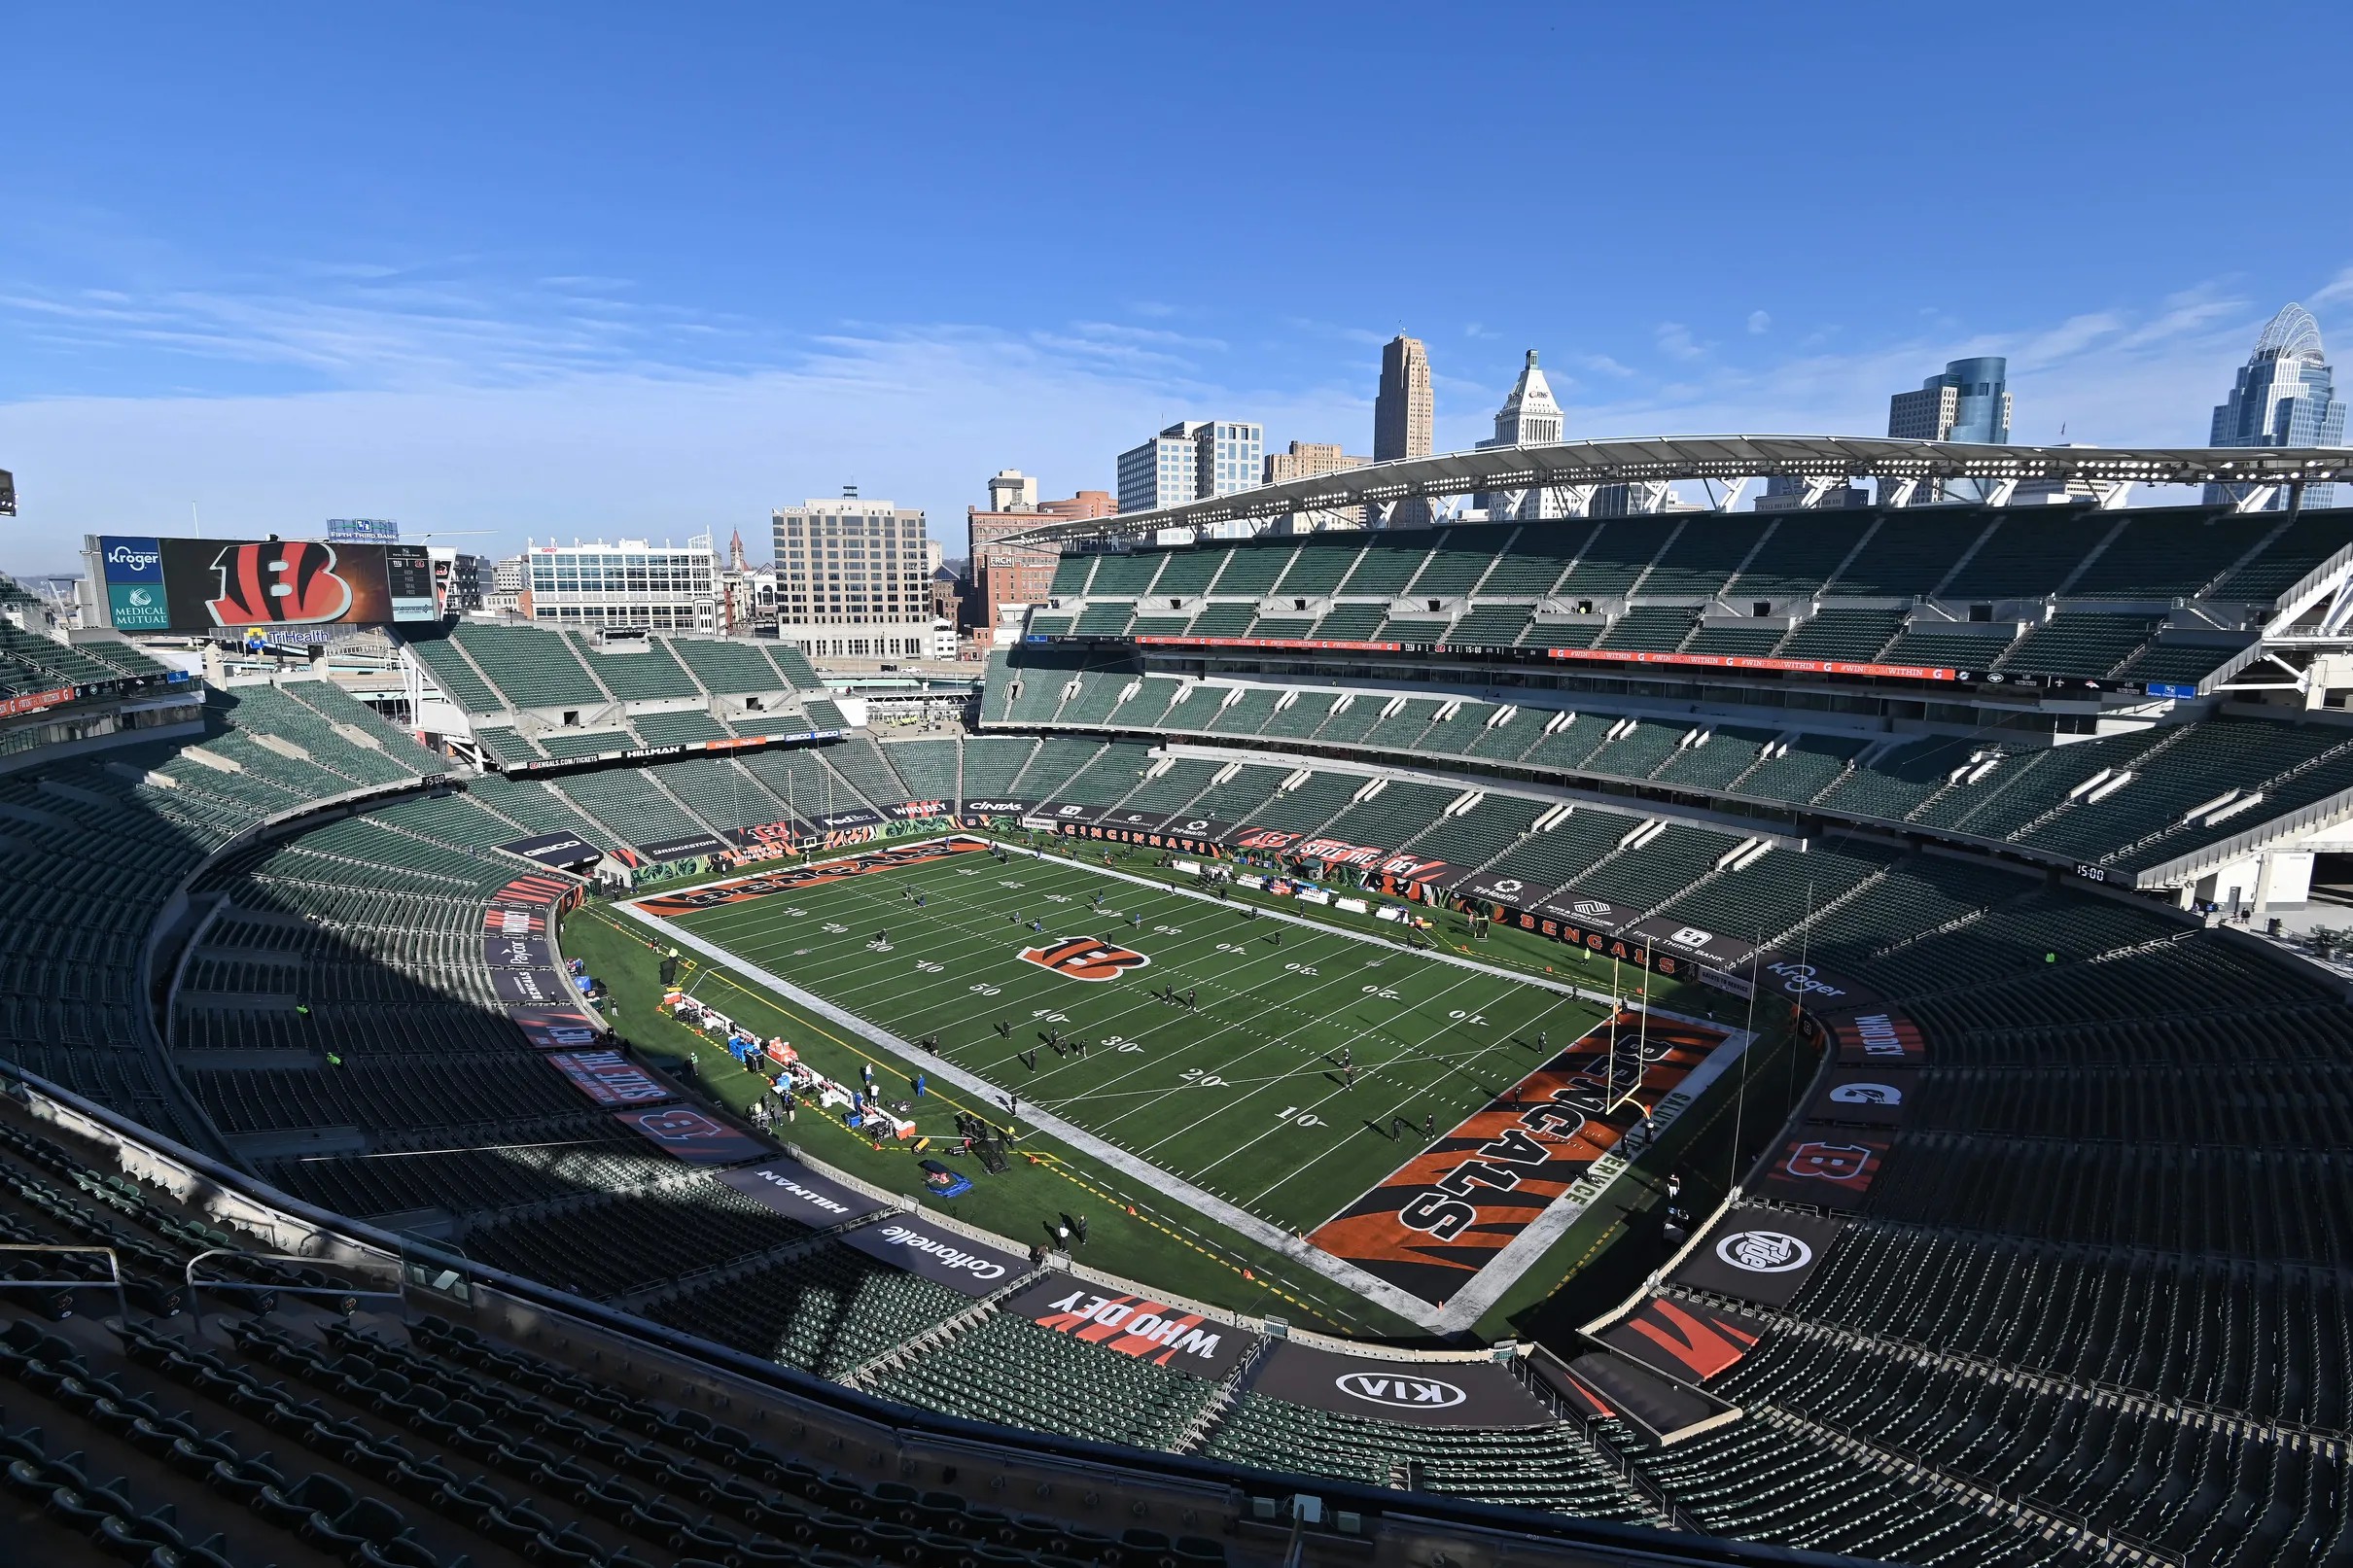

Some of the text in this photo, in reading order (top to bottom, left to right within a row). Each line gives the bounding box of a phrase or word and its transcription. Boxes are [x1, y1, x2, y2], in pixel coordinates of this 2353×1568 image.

[108, 546, 158, 571] Kroger
[116, 607, 166, 615] MEDICAL
[117, 615, 165, 624] MUTUAL
[268, 630, 330, 643] TriHealth
[1652, 654, 1718, 664] #WINFROMWITHIN
[1740, 659, 1815, 670] #WINFROMWITHIN
[1841, 665, 1923, 677] #WINFROMWITHIN
[626, 747, 681, 757] HILLMAN
[892, 803, 947, 815] WHO DEY
[1065, 824, 1206, 854] CINCINNATI
[1171, 826, 1207, 837] TriHealth
[523, 840, 581, 857] GEICO
[652, 839, 718, 855] BRIDGESTONE
[1300, 843, 1347, 859] SEIZE
[1343, 850, 1378, 865] THE
[685, 846, 953, 904] BENGALS
[1383, 860, 1424, 875] DEY
[1472, 885, 1520, 902] TriHealth
[1153, 925, 1181, 935] 50
[509, 940, 533, 964] Paycor
[1216, 943, 1246, 954] 40
[1520, 914, 1675, 974] BENGALS
[1633, 930, 1726, 962] FIFTH THIRD BANK
[916, 959, 944, 972] 40
[1285, 962, 1317, 975] 30
[519, 972, 544, 999] BENGALS
[969, 983, 1001, 996] 50
[1766, 961, 1846, 997] Kroger
[1362, 985, 1396, 999] 20
[1032, 1008, 1065, 1022] 40
[1449, 1010, 1485, 1025] 10
[1102, 1035, 1138, 1053] 30
[1854, 1014, 1905, 1056] WHO DEY
[572, 1050, 629, 1071] THE
[594, 1070, 667, 1100] SEIZE
[1178, 1068, 1222, 1087] 20
[1830, 1083, 1902, 1104] G
[1275, 1106, 1318, 1127] 10
[1398, 1033, 1674, 1242] BENGALS
[755, 1169, 850, 1214] HILLMAN
[881, 1225, 1005, 1279] Cottonelle
[1739, 1232, 1792, 1270] Tide
[1048, 1290, 1222, 1360] WHO DEY
[1355, 1376, 1445, 1404] KIA
